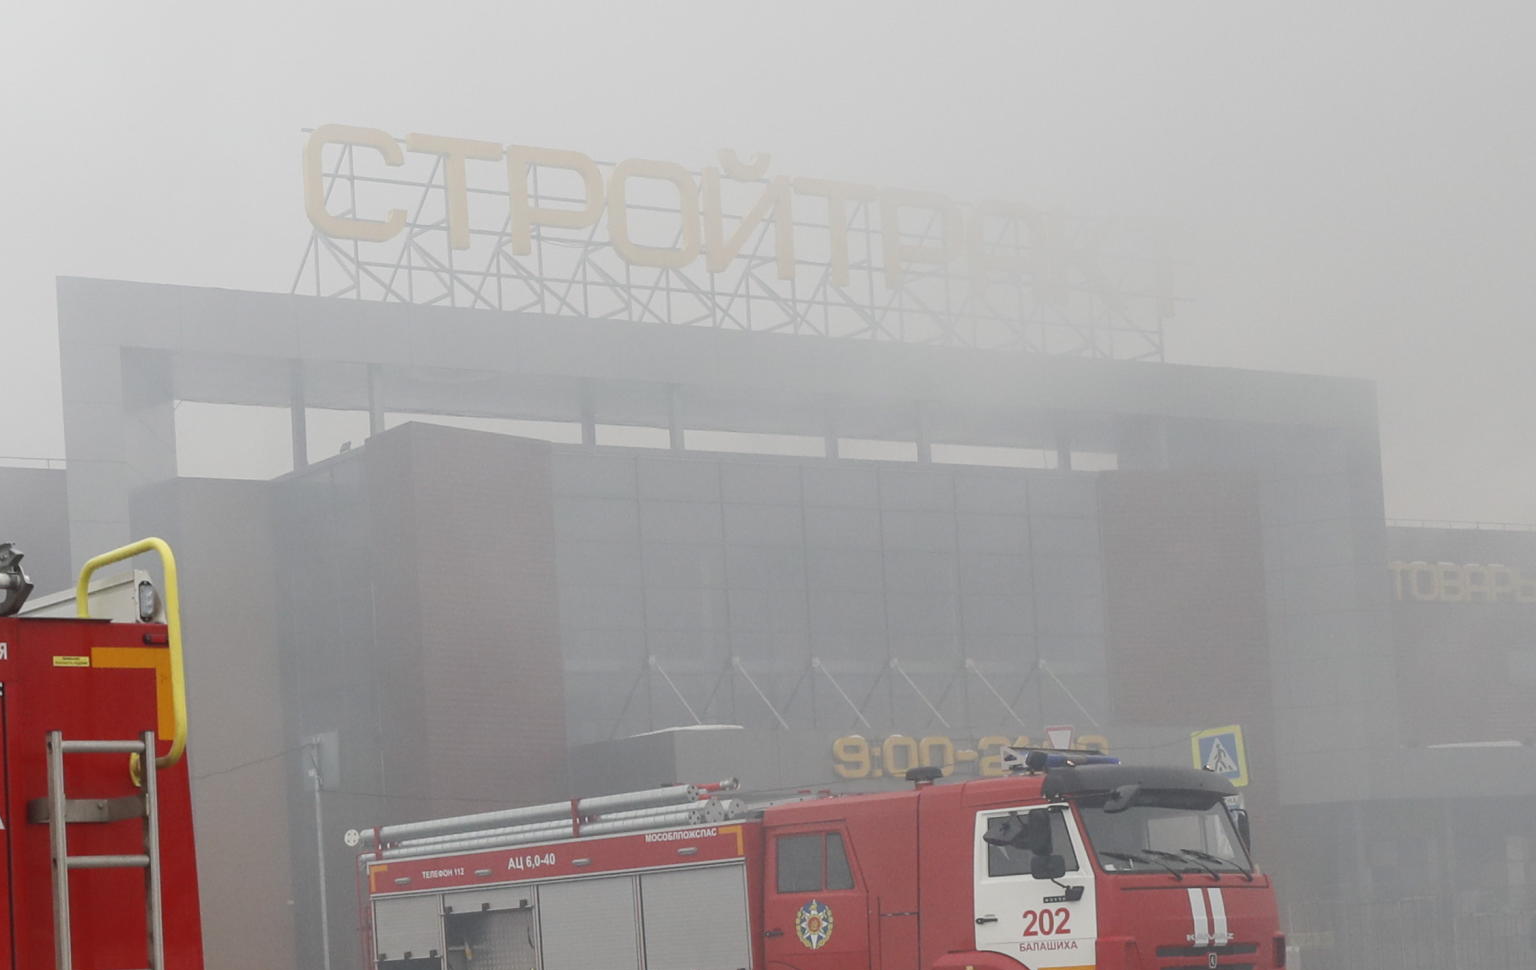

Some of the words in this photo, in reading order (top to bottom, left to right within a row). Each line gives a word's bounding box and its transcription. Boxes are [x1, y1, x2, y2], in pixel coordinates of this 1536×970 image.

[645, 828, 717, 843] МОСОБЛПОЖСПАС
[507, 856, 524, 871] АЦ
[526, 853, 556, 869] 6,0-40
[421, 868, 453, 879] ТЕЛЕФОН
[454, 867, 465, 877] 112
[1022, 907, 1071, 937] 202
[1019, 940, 1078, 952] БАЛАШИХА
